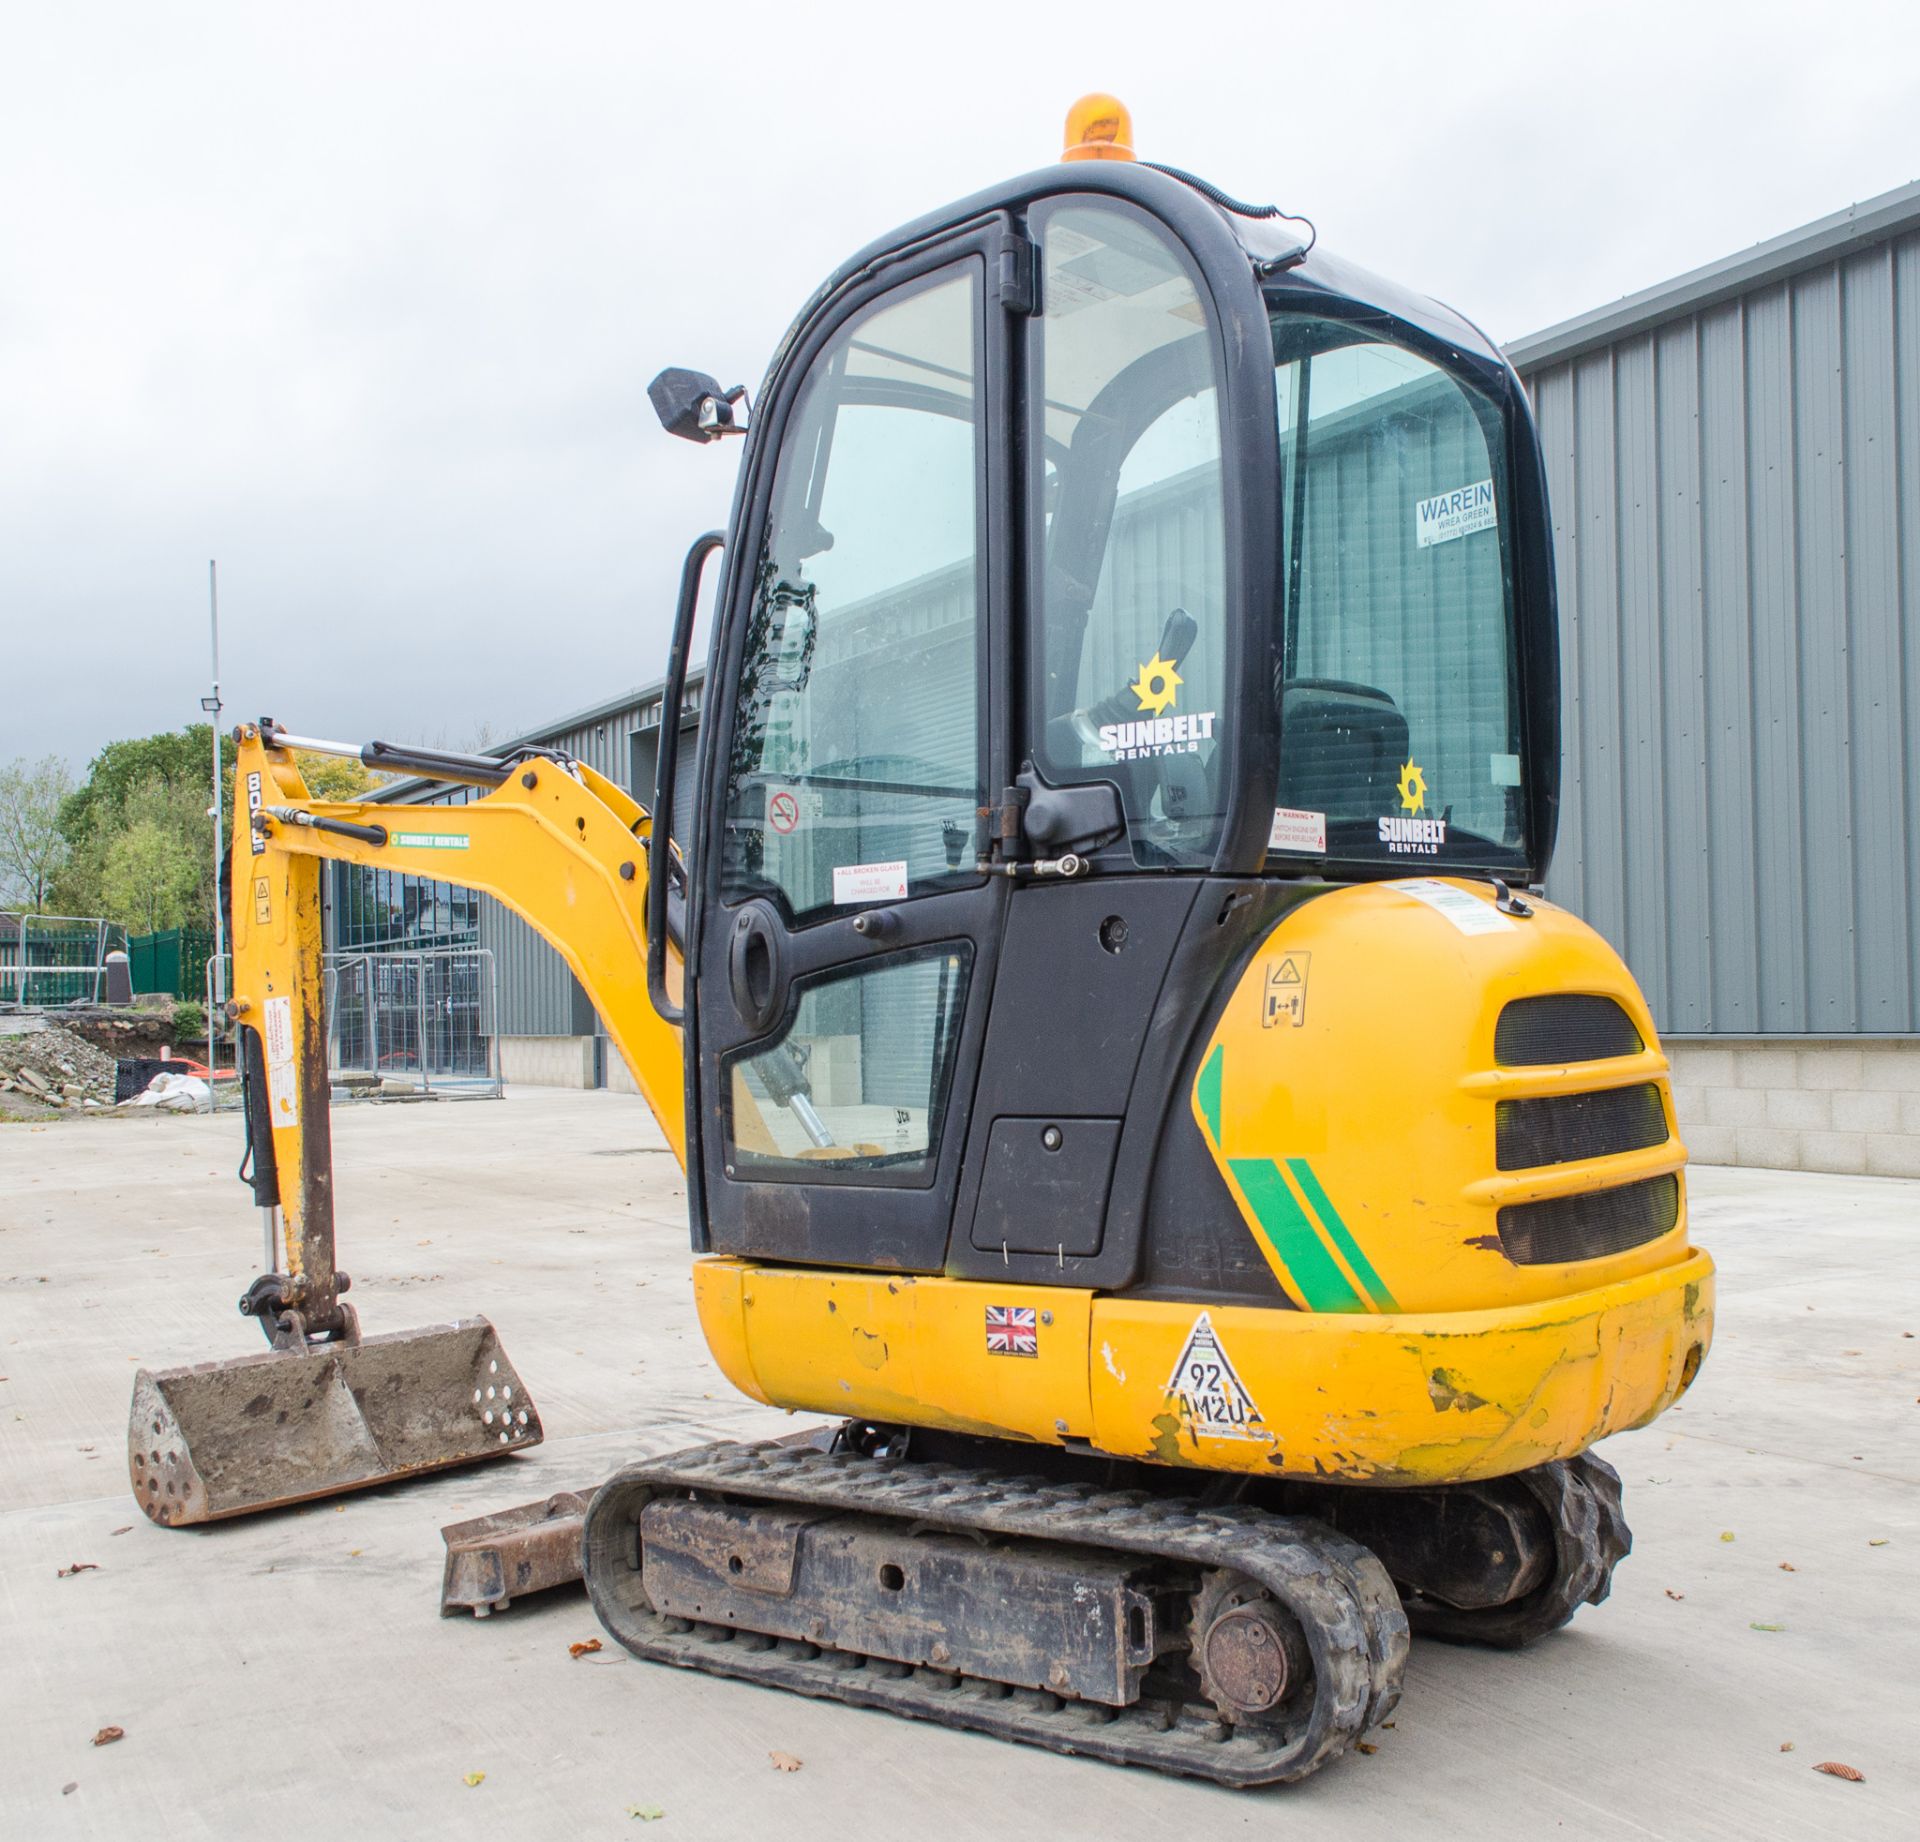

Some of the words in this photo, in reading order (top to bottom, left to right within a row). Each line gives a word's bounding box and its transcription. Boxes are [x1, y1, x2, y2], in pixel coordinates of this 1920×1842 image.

[1438, 516, 1461, 530] WREA
[1462, 506, 1489, 522] GREEN
[1100, 712, 1216, 752] SUNBELT
[1115, 741, 1198, 761] RENTALS
[1282, 812, 1309, 820] WARNING
[400, 835, 433, 846] SUNBELT
[434, 836, 469, 848] RENTALS
[1378, 817, 1446, 844] SUNBELT
[1389, 842, 1438, 855] RENTALS
[854, 867, 879, 875] BROKEN
[881, 865, 900, 873] GLASS
[1191, 1363, 1220, 1392] 92
[1179, 1393, 1245, 1424] AM2U
